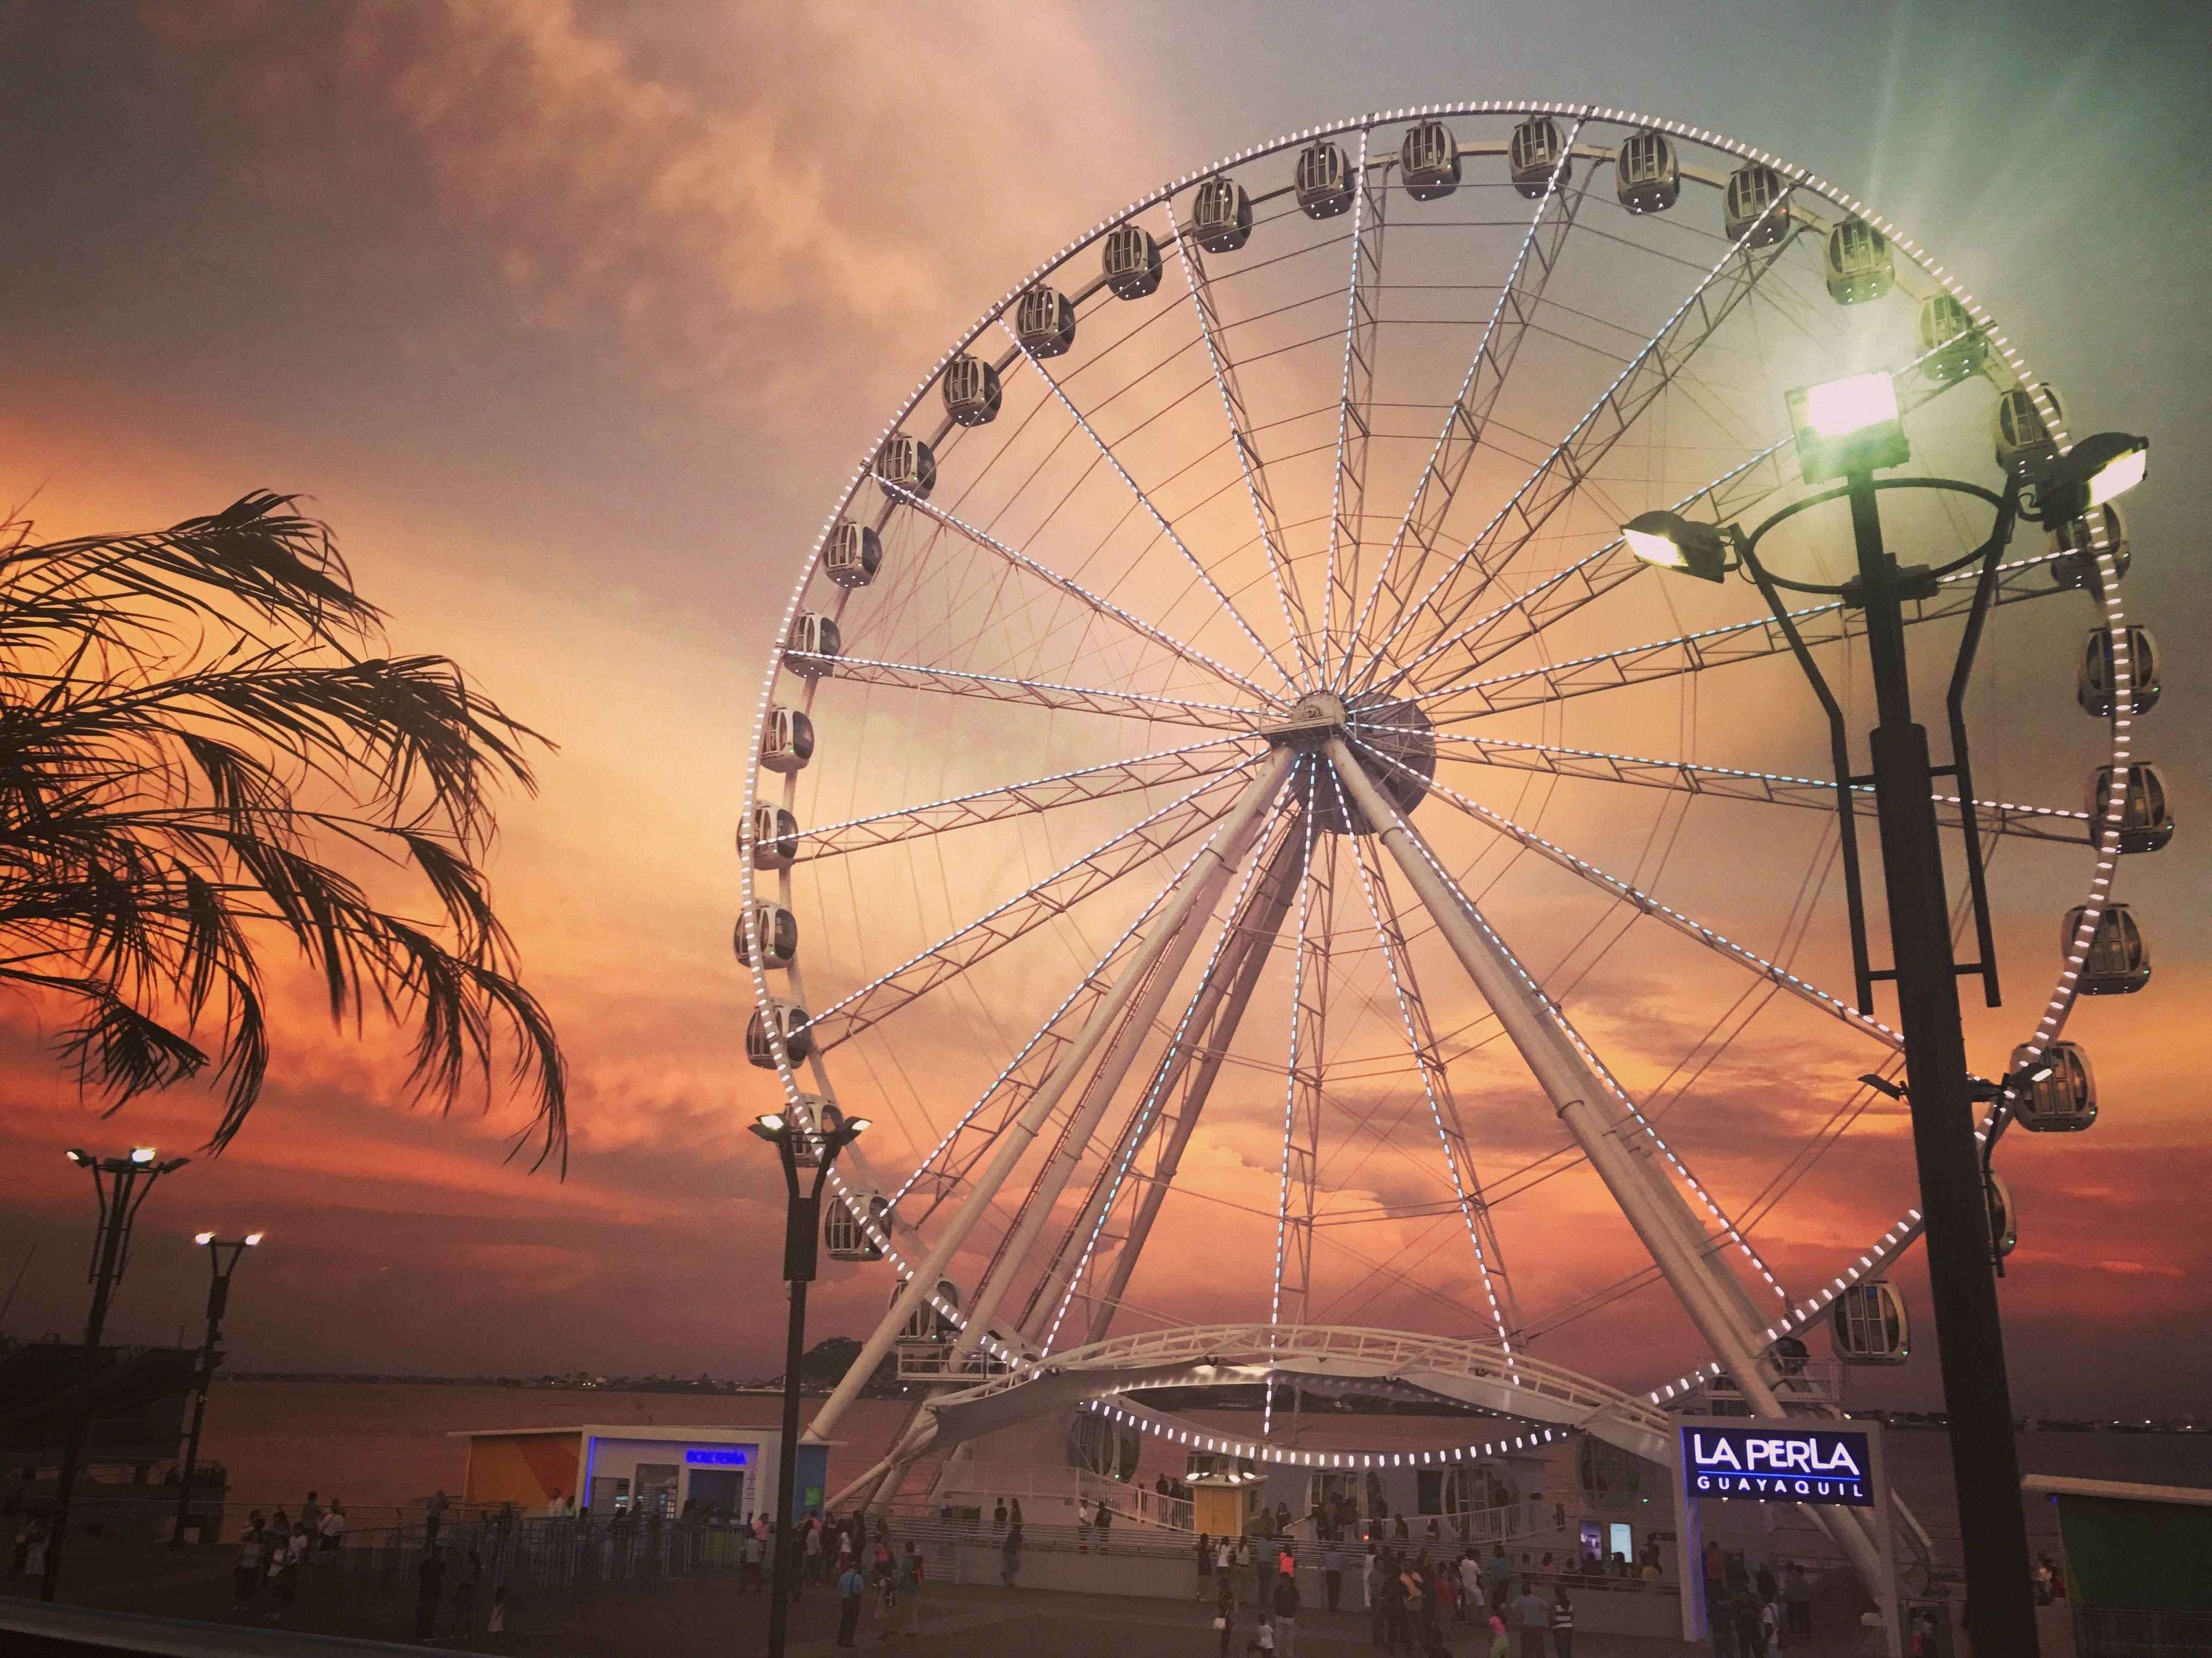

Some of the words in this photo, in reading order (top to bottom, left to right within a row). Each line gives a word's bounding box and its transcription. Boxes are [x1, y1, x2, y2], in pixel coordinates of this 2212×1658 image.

[1694, 1434, 1741, 1470] LA
[1746, 1438, 1860, 1475] PERLA
[1697, 1476, 1863, 1497] GUAYAQUIL
